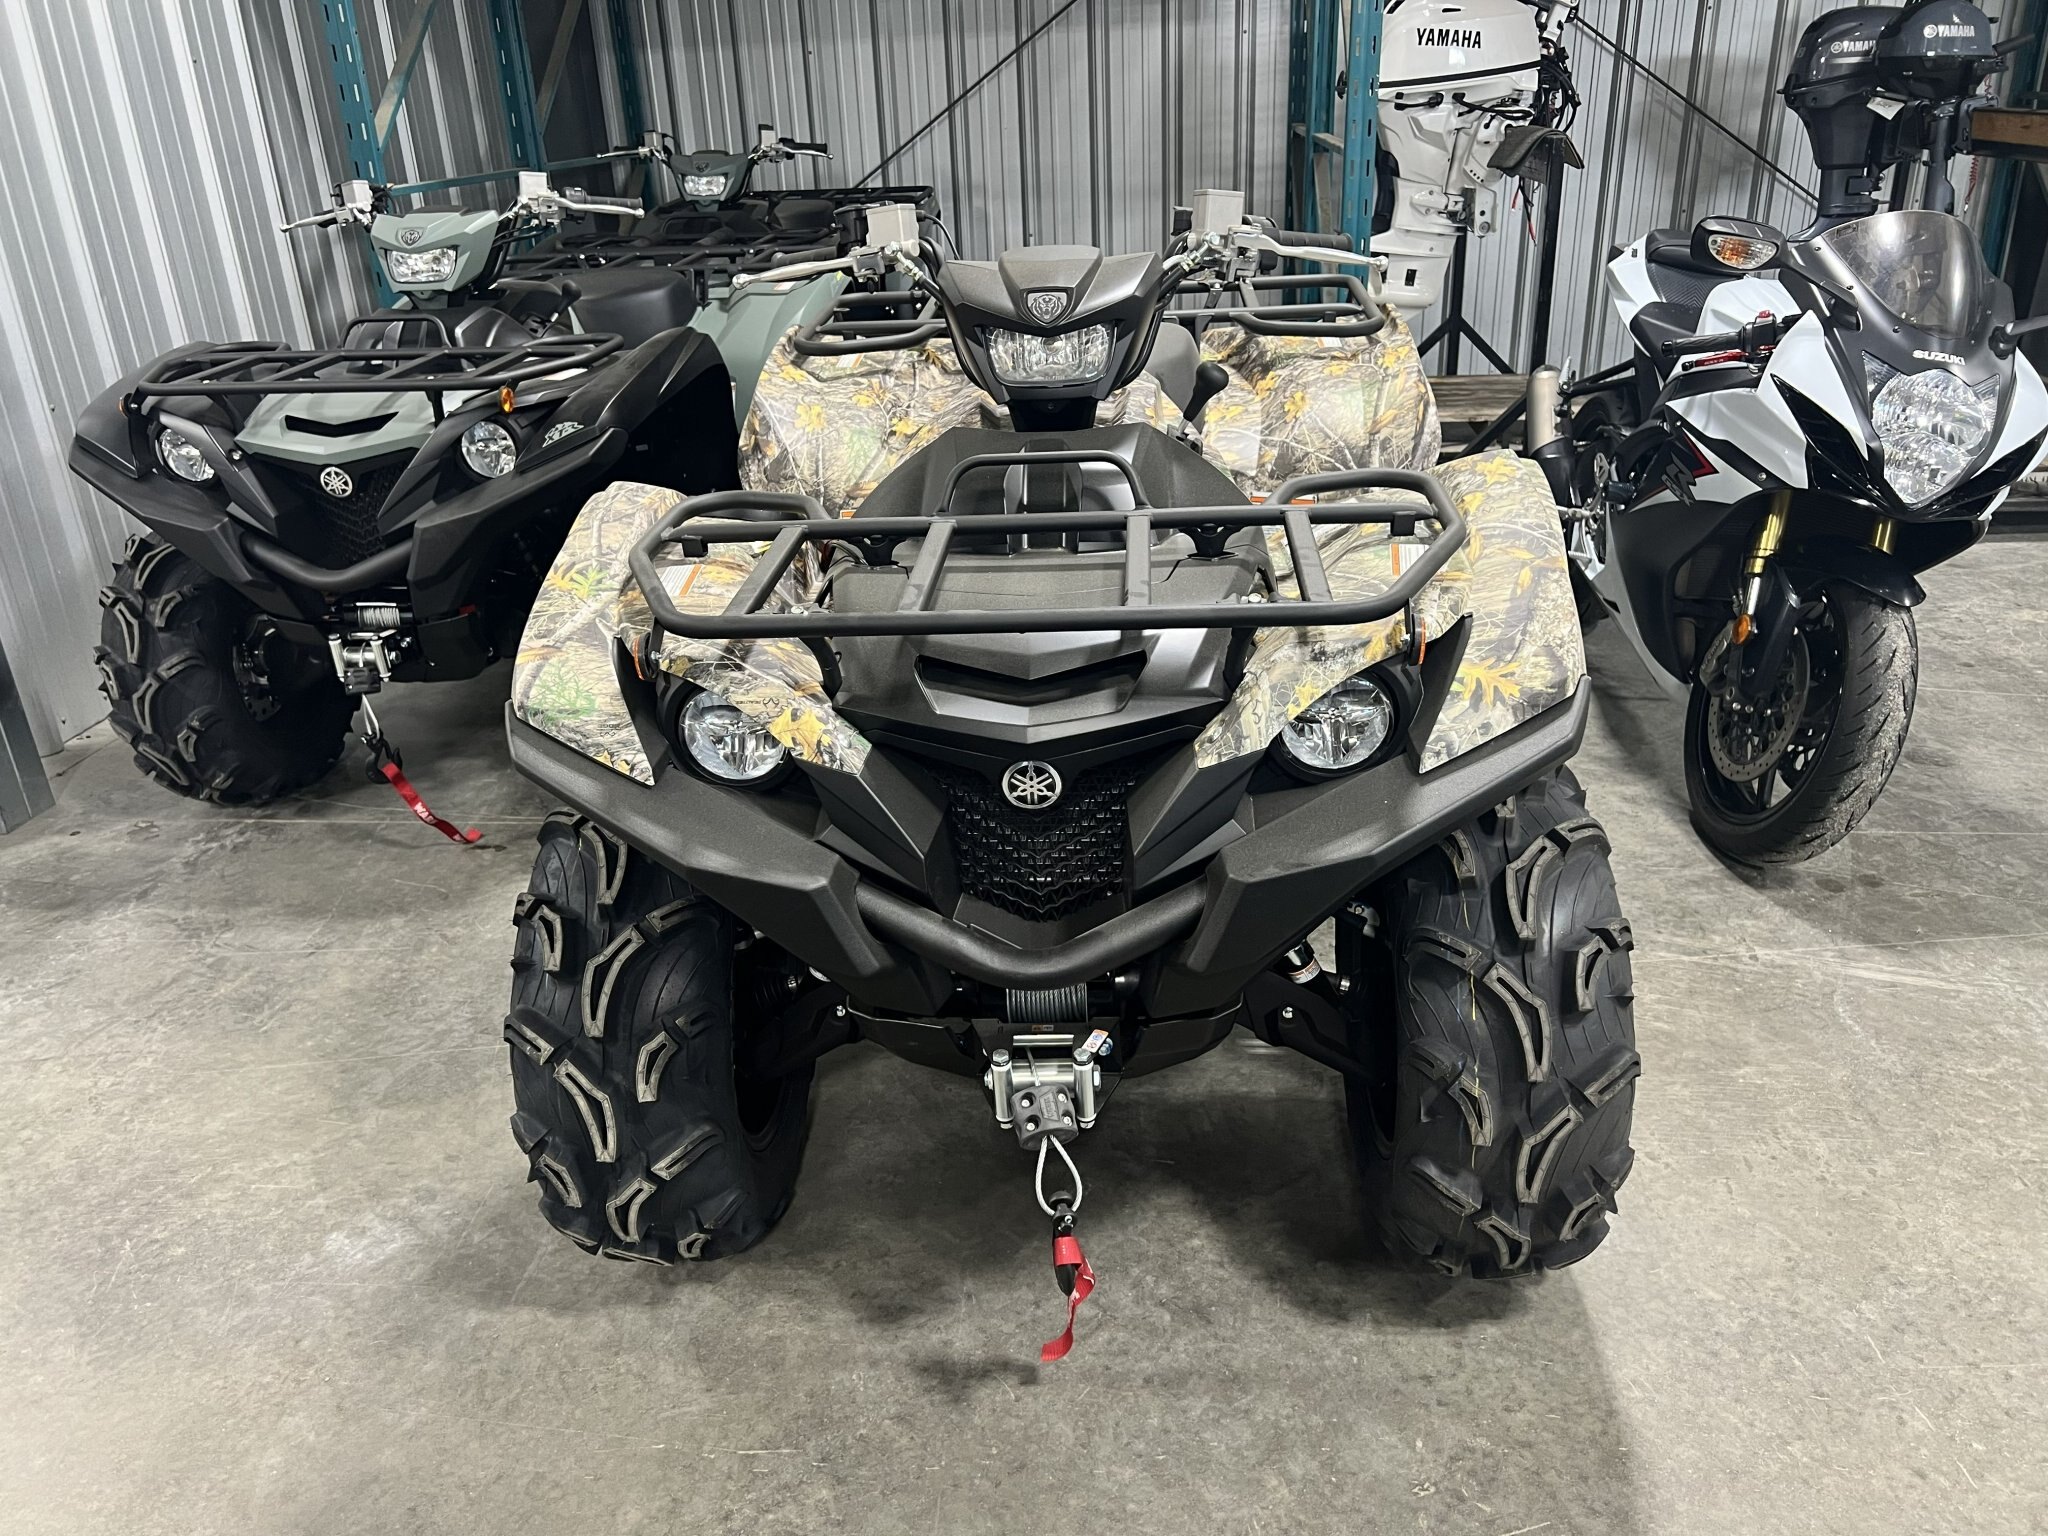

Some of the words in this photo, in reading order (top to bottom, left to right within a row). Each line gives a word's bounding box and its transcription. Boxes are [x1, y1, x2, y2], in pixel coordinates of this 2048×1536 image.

[1937, 24, 1975, 37] YAMAHA
[1417, 28, 1481, 49] YAMAHA
[1842, 40, 1876, 52] YAMAH
[1912, 349, 1966, 366] SUZUKI
